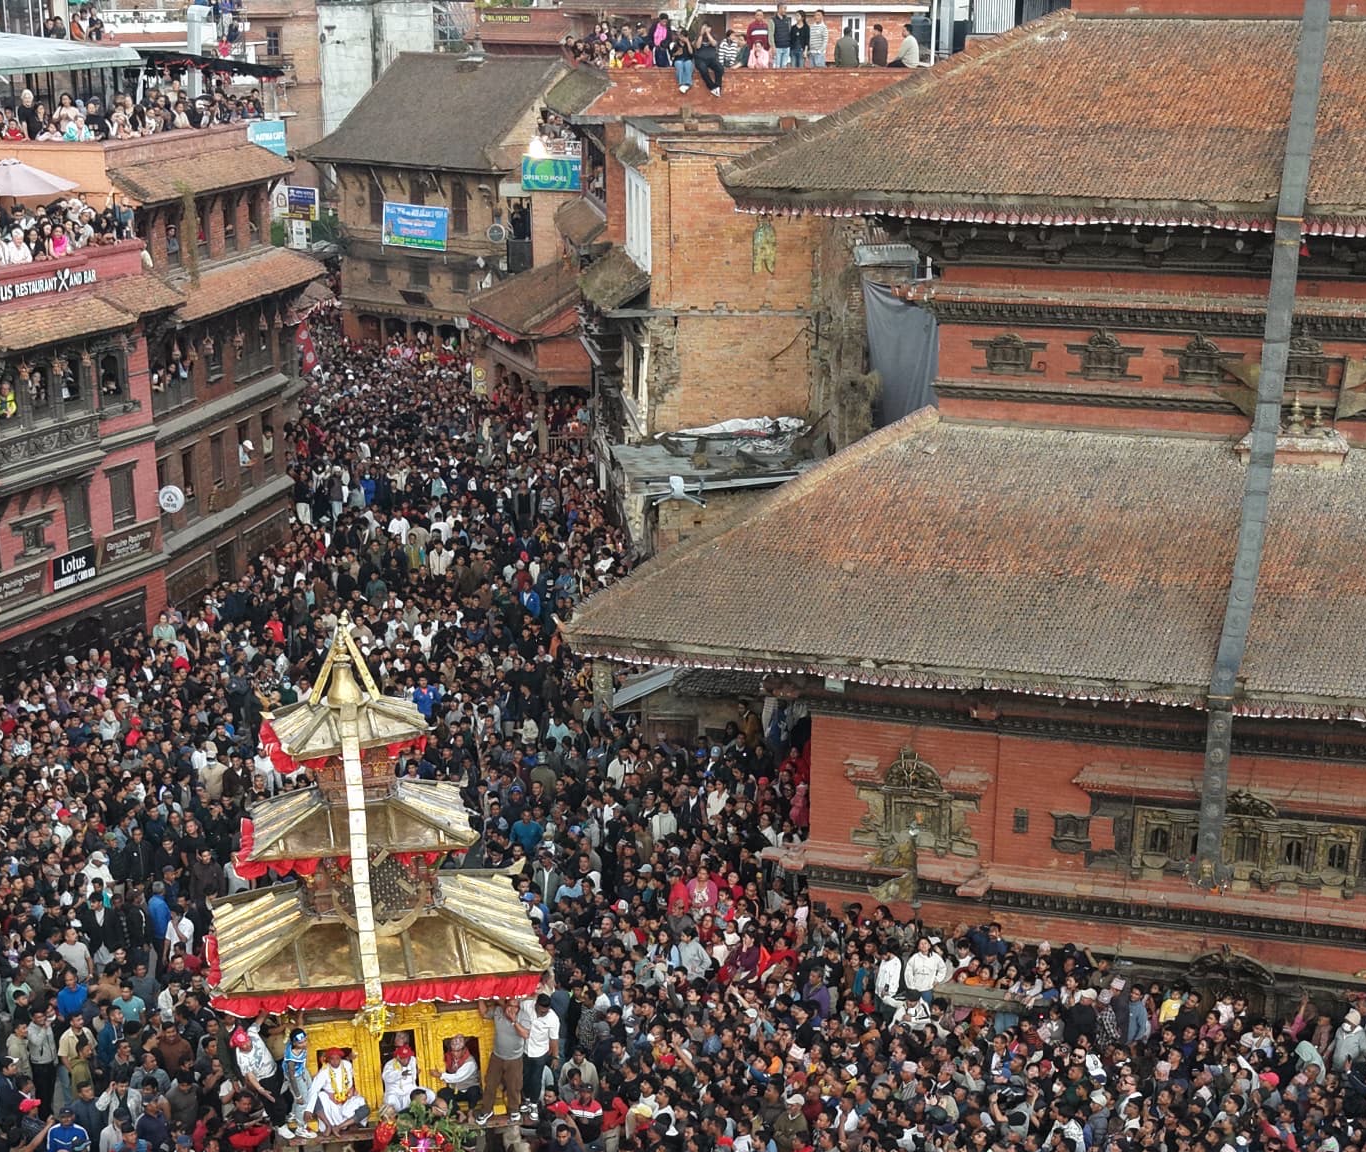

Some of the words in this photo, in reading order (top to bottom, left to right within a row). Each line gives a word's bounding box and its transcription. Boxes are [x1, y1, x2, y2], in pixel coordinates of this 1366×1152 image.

[15, 277, 57, 298] RESTAURANT
[68, 271, 82, 287] AND
[84, 269, 97, 285] BAR
[61, 555, 86, 575] Lotus
